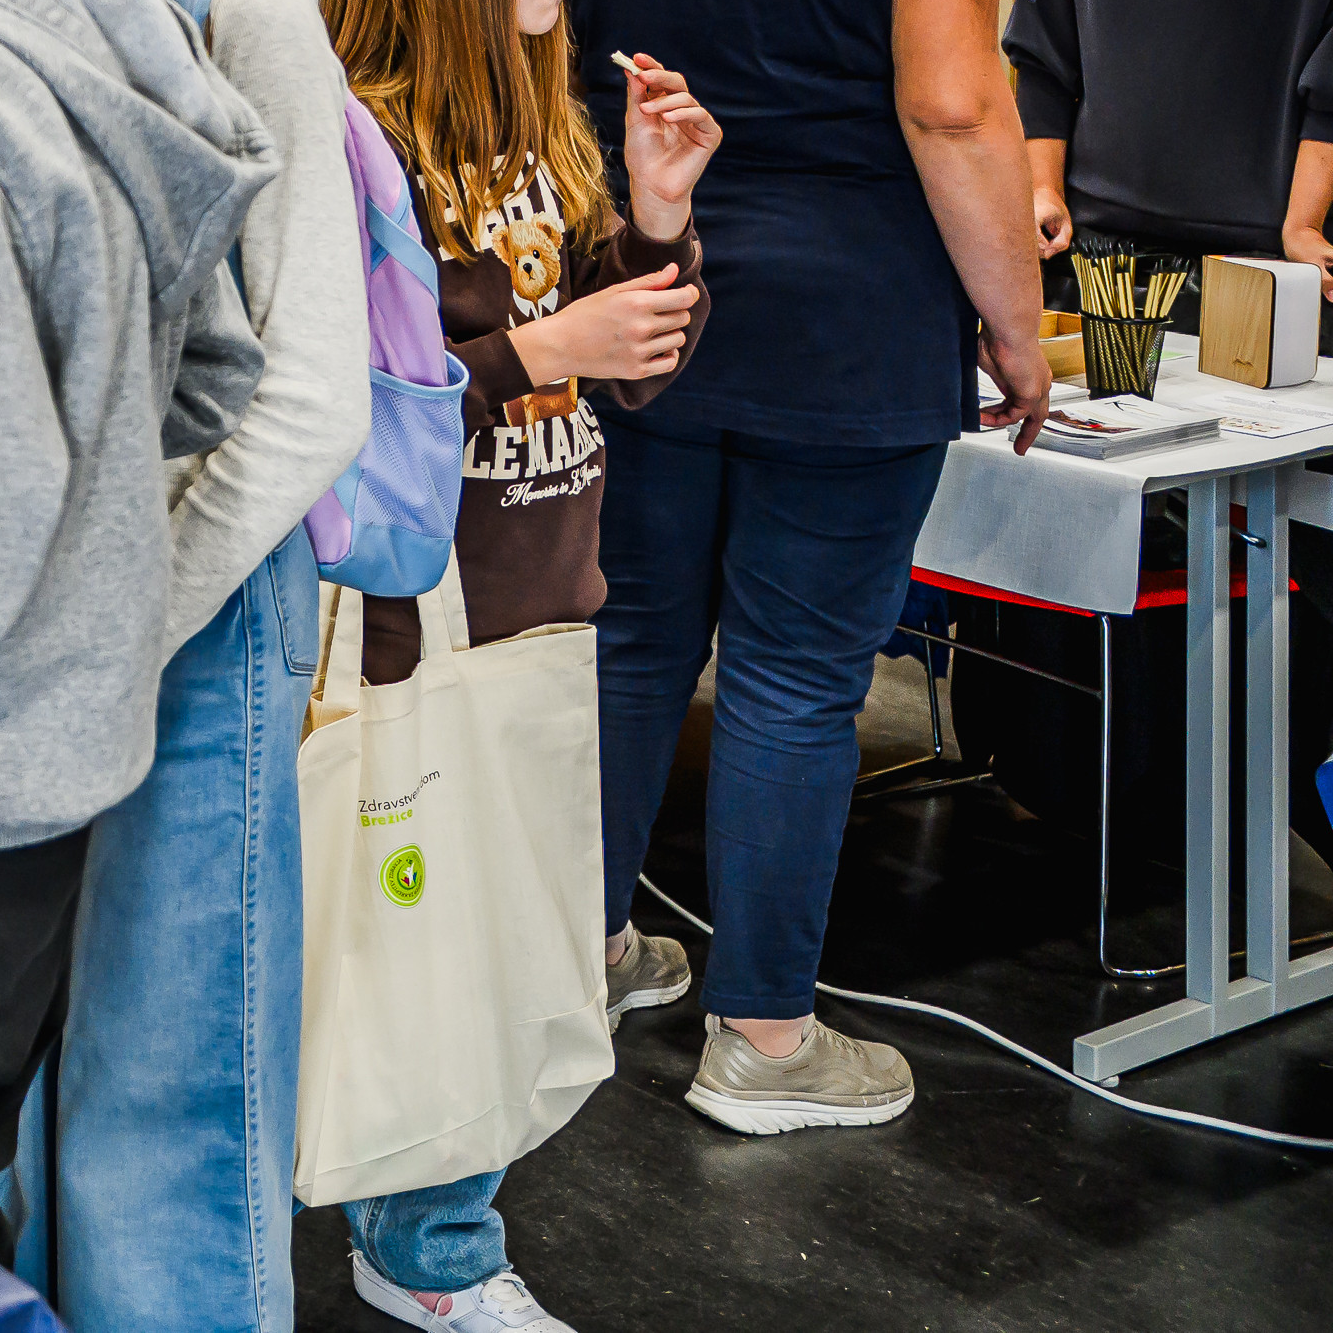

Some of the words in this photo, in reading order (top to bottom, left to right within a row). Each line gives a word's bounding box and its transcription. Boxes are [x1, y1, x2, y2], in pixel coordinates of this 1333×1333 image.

[462, 426, 523, 480] LE
[358, 786, 420, 813] Zdravstve
[360, 809, 413, 827] Brežice
